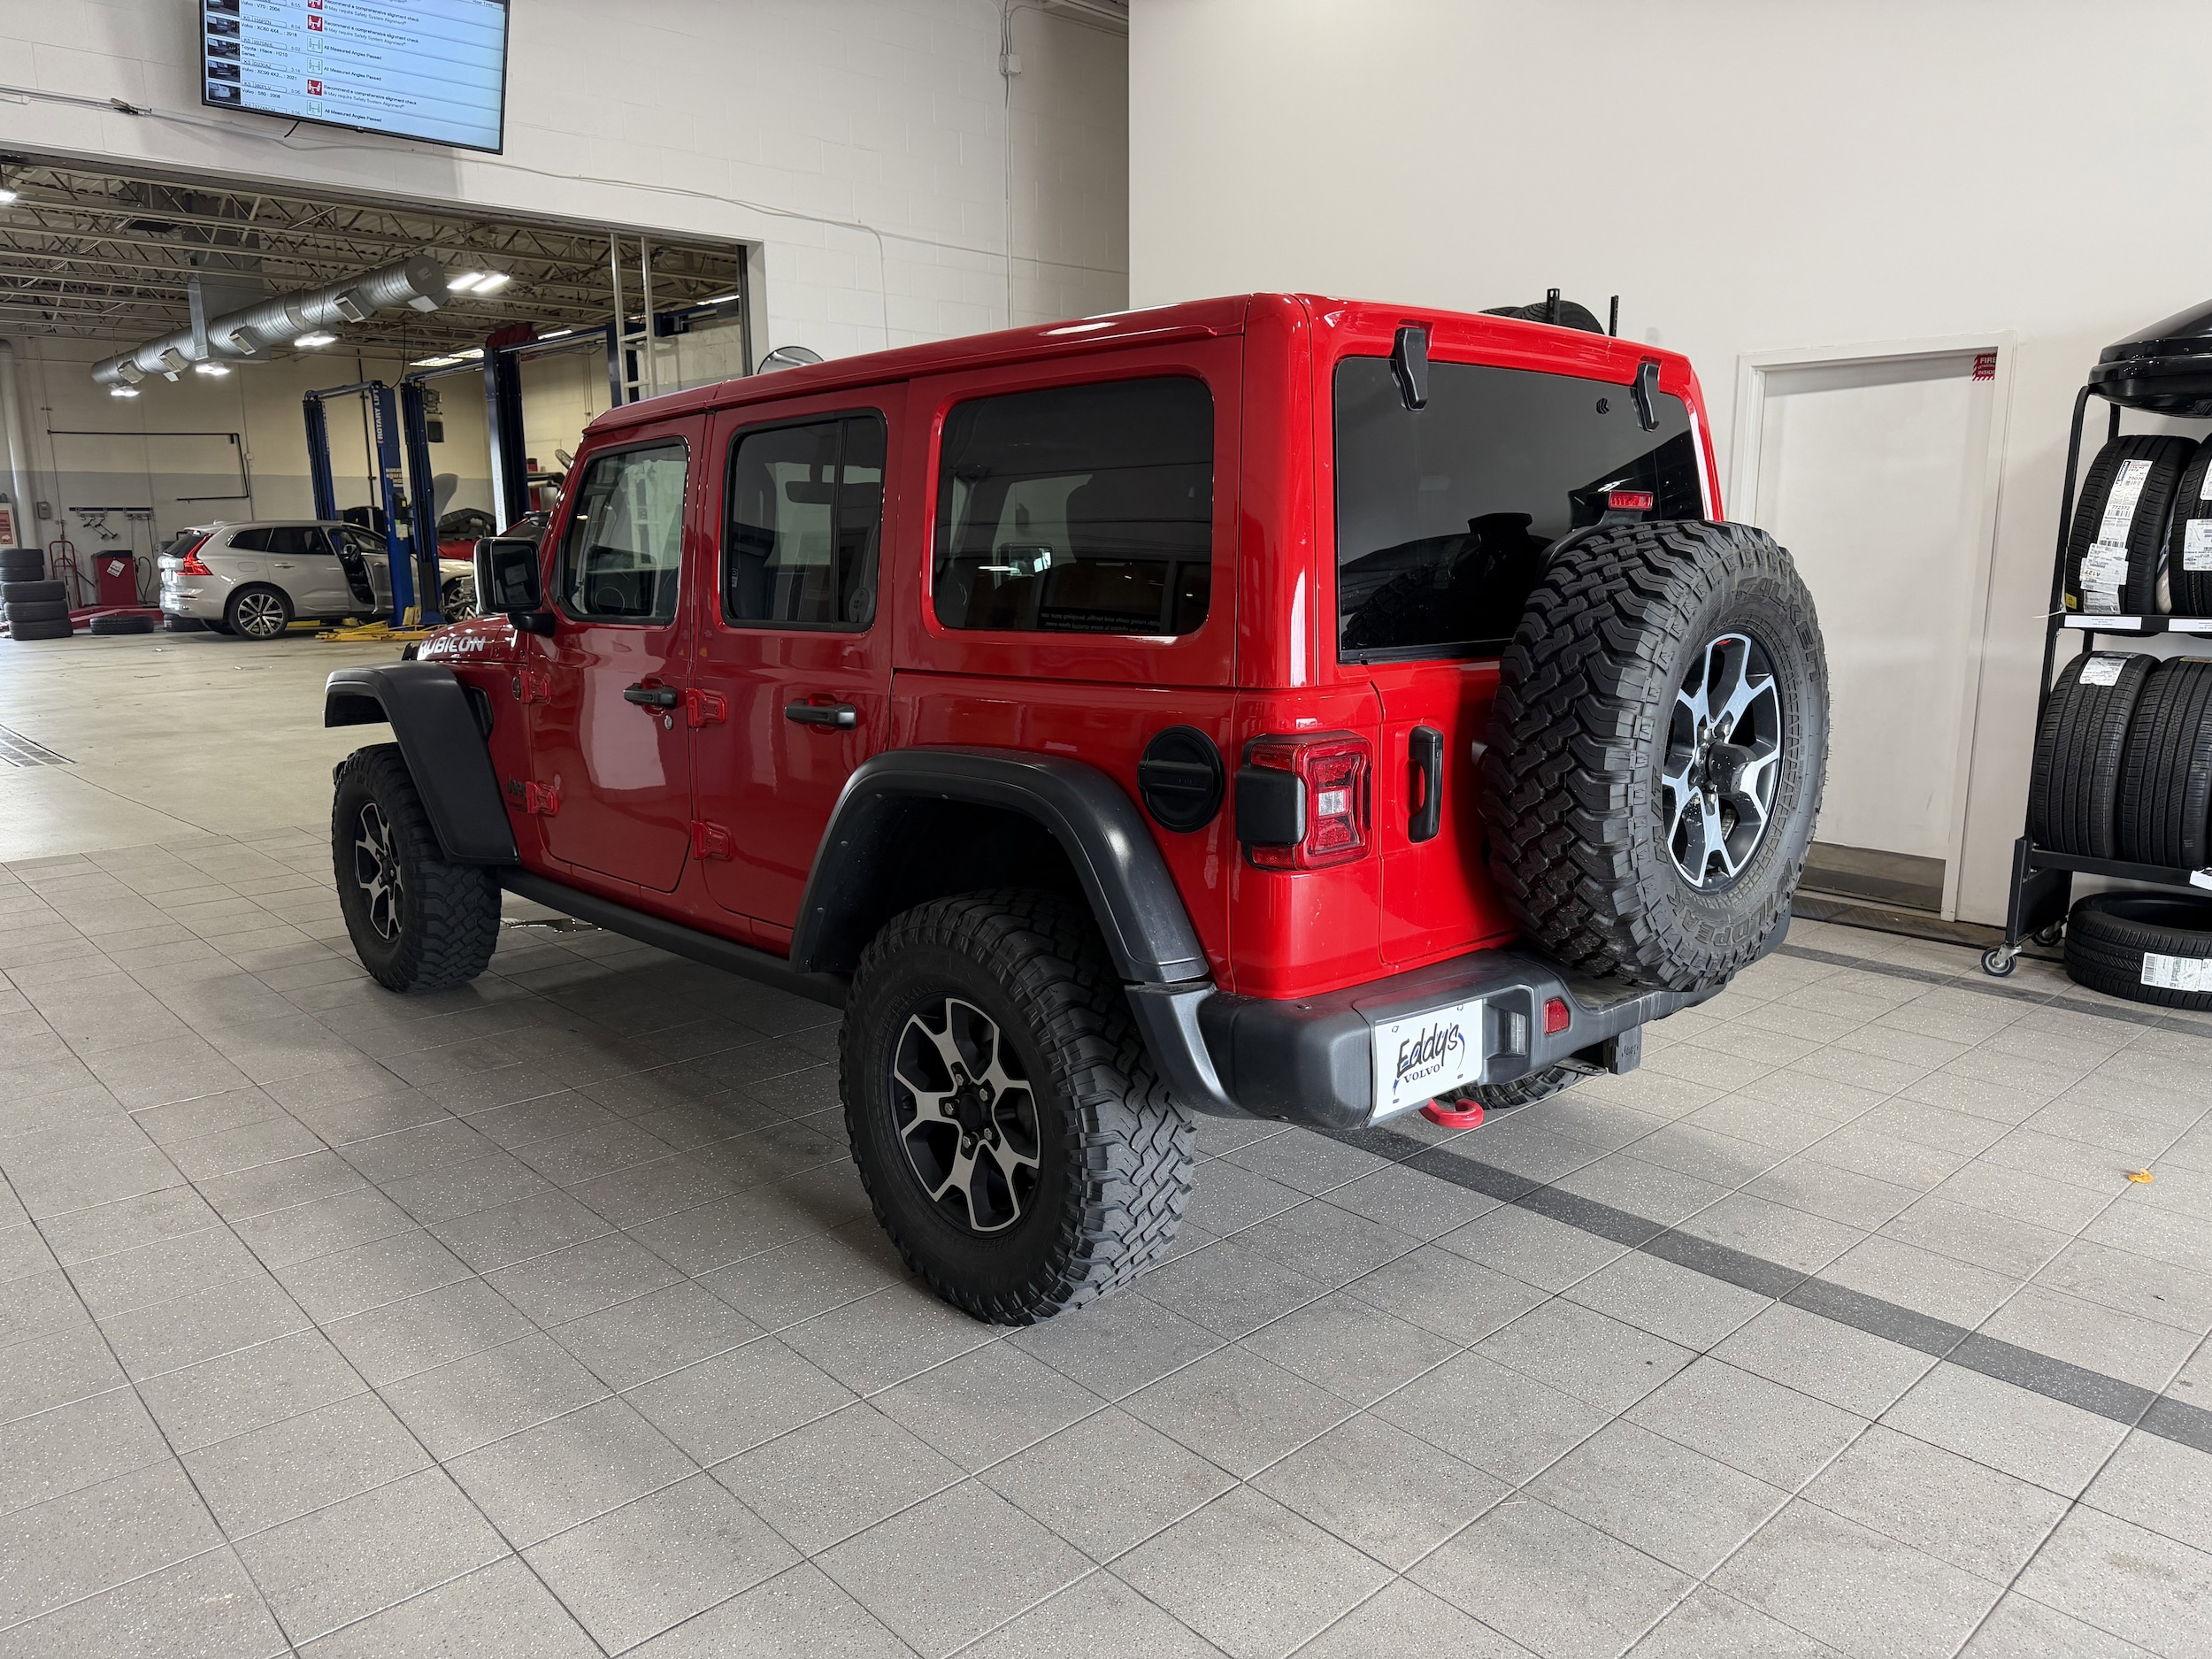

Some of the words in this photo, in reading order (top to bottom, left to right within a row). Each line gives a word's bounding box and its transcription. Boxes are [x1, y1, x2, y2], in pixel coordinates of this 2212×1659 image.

[355, 5, 387, 16] comprehensive
[324, 19, 350, 30] Recommend
[355, 27, 386, 37] comprehensive
[354, 32, 368, 41] Safety
[324, 84, 349, 94] Recommend
[354, 90, 385, 100] comprehensive
[371, 389, 380, 406] LIFT
[373, 407, 383, 440] ROTARY
[418, 635, 487, 656] RUBICON
[1396, 1023, 1459, 1079] Eddy's
[1621, 1044, 1639, 1057] Jeep
[1403, 1064, 1440, 1083] VOLVO
